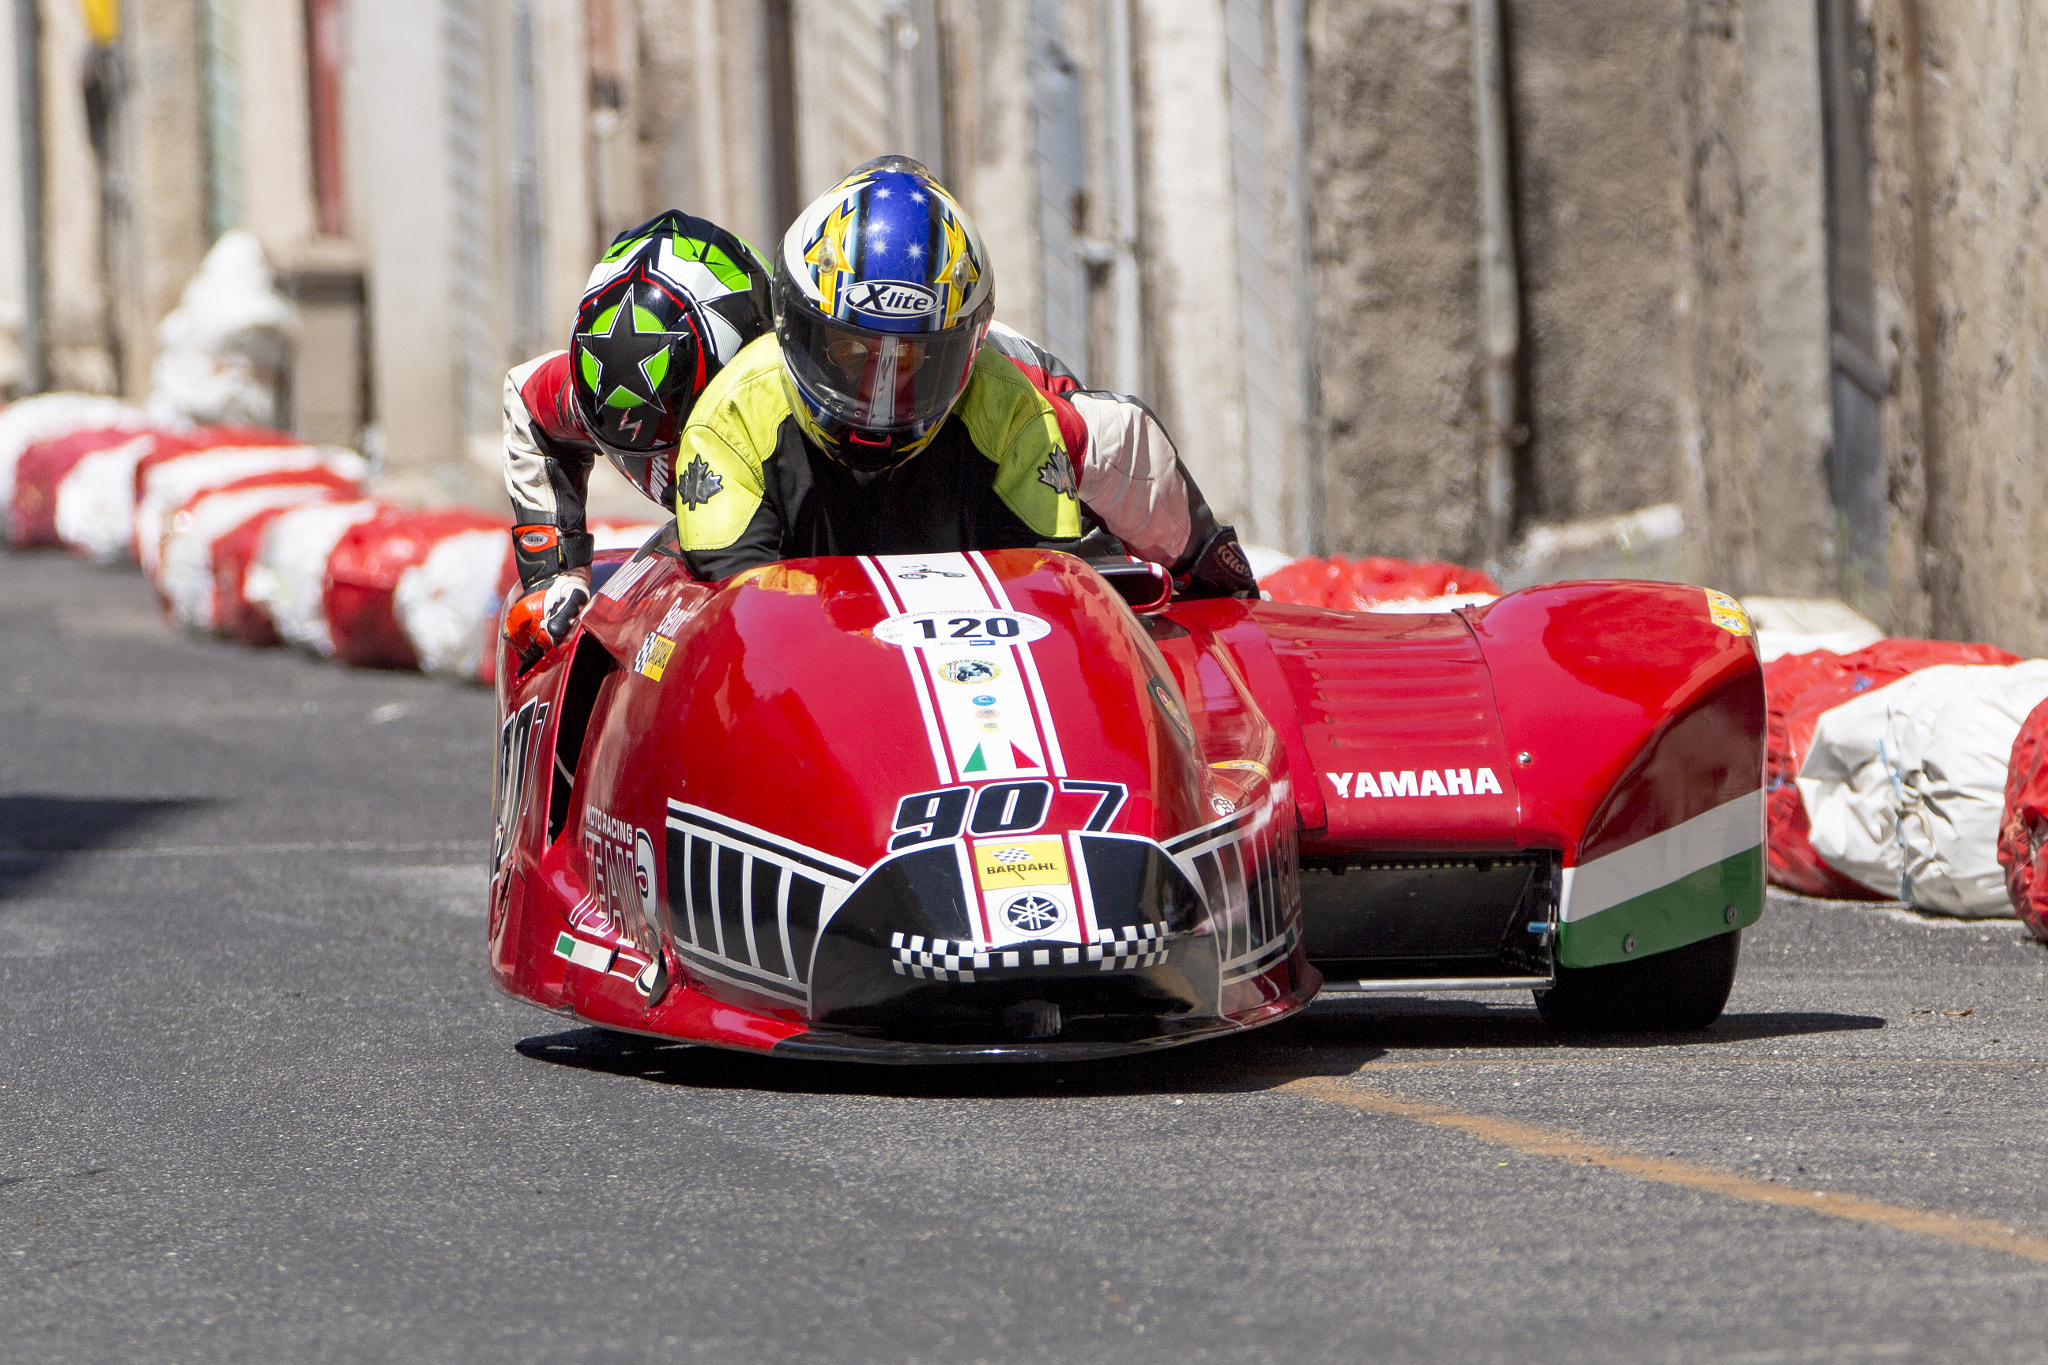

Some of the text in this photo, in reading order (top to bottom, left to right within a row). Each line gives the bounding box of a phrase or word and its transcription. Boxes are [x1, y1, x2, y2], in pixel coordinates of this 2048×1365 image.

[854, 283, 929, 311] X-lite
[913, 617, 1020, 639] 120
[1326, 767, 1504, 798] YAMAHA
[602, 812, 633, 845] RACING
[887, 779, 1129, 853] 907
[986, 862, 1059, 875] BARDAHL
